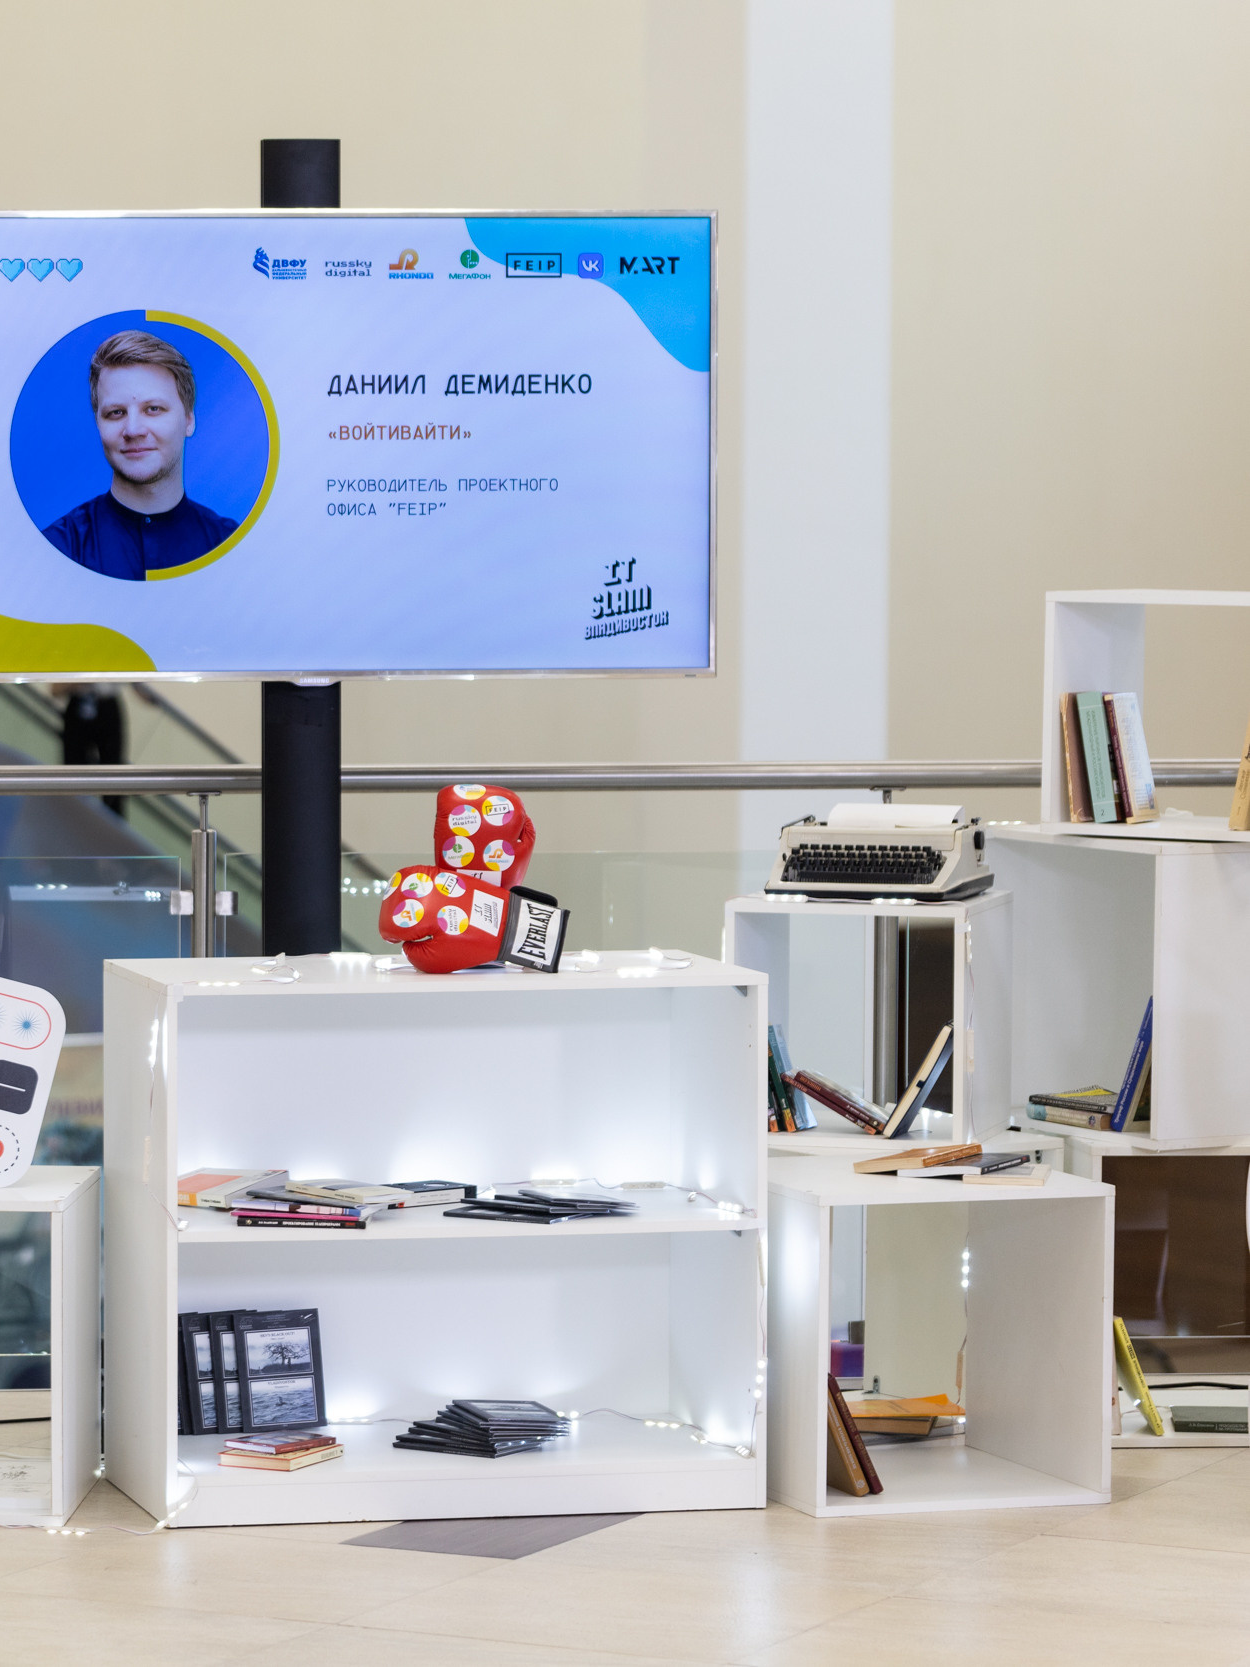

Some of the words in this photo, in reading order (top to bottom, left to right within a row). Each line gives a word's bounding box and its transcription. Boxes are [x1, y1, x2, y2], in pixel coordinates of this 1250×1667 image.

[271, 259, 307, 268] ДВФУ
[325, 260, 372, 268] russky
[513, 260, 556, 271] FEIP
[582, 259, 600, 272] VK
[325, 268, 372, 278] digital
[327, 374, 426, 396] ДАНИИЛ
[444, 374, 592, 396] ДЕМИДЕНКО
[328, 422, 472, 441] «ВОЙТИВАЙТИ»
[327, 478, 448, 493] РУКОВОДИТЕЛЬ
[458, 478, 559, 492] ПРОЕКТНОГО
[327, 502, 377, 516] ОФИСА
[584, 609, 670, 641] ВЛАДИВОСТОК
[517, 902, 556, 961] EVERLAST
